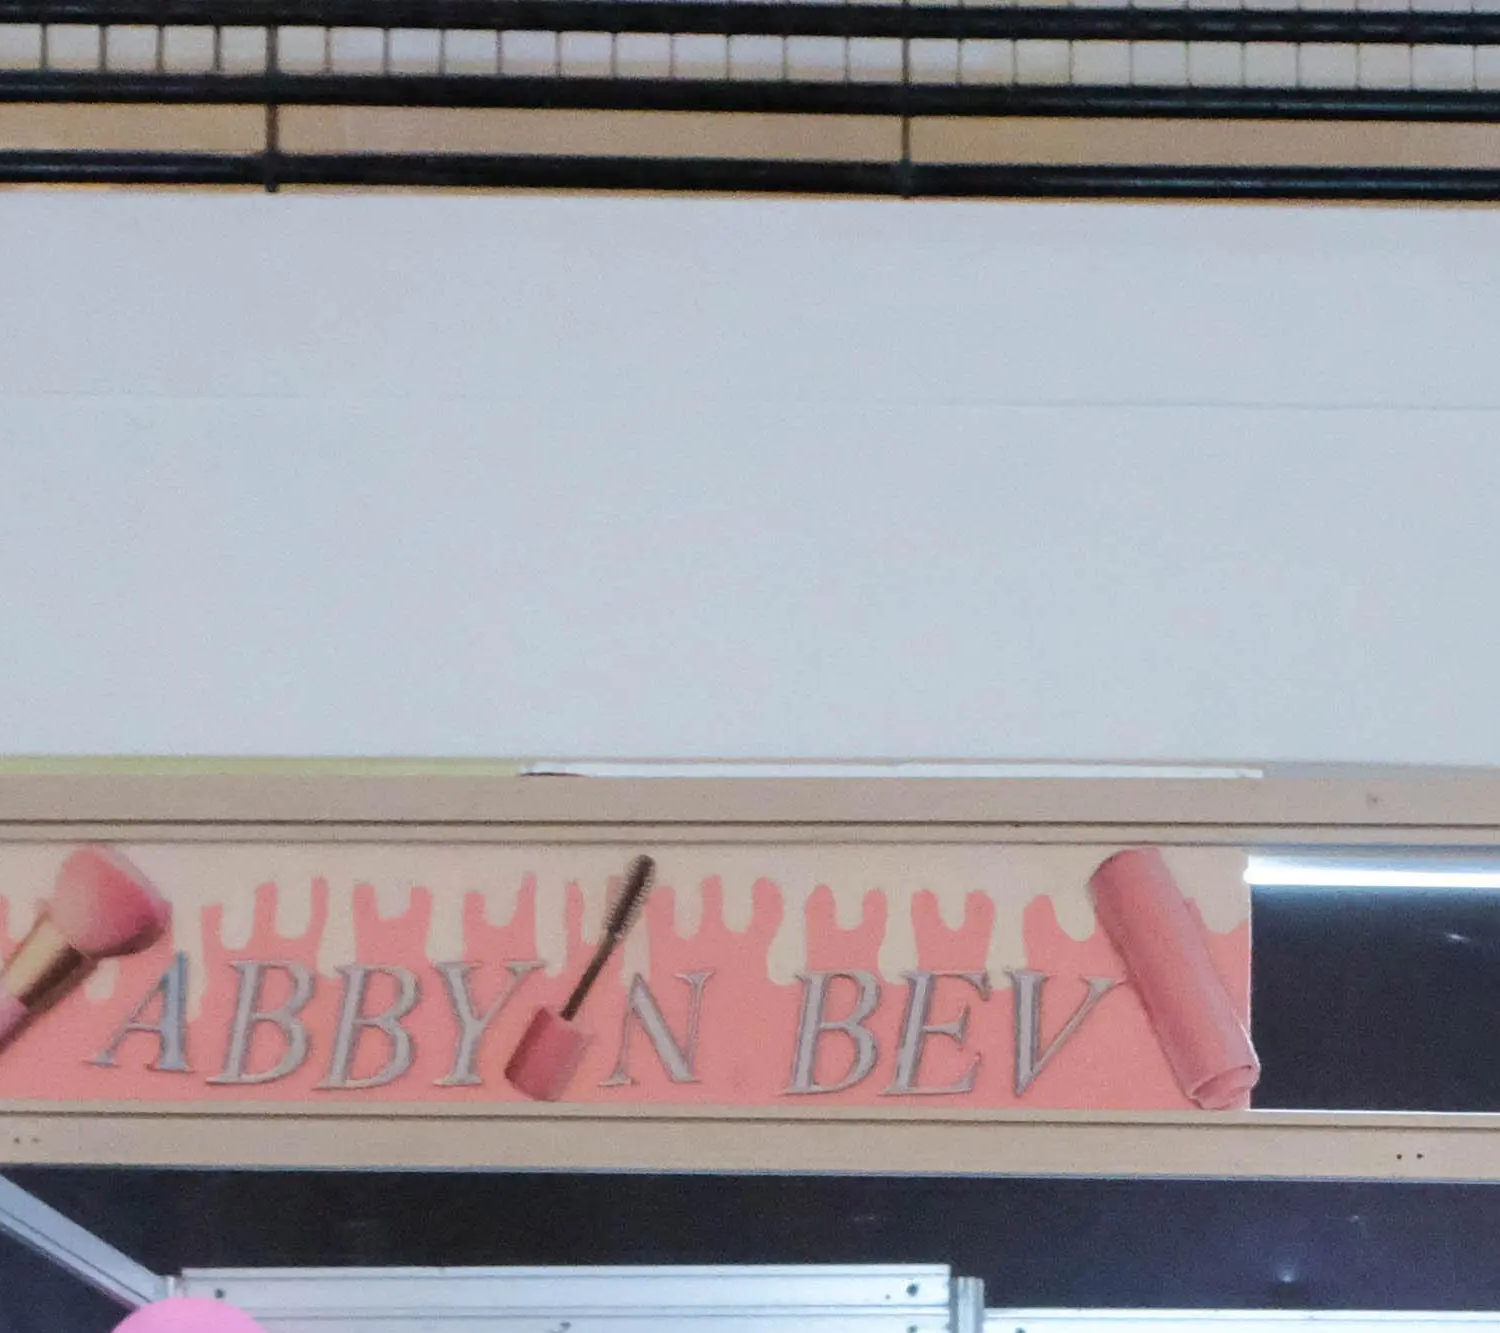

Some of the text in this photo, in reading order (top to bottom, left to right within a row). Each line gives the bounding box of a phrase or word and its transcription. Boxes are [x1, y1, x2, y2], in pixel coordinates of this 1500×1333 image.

[88, 950, 1128, 1097] ABBY N BEV
